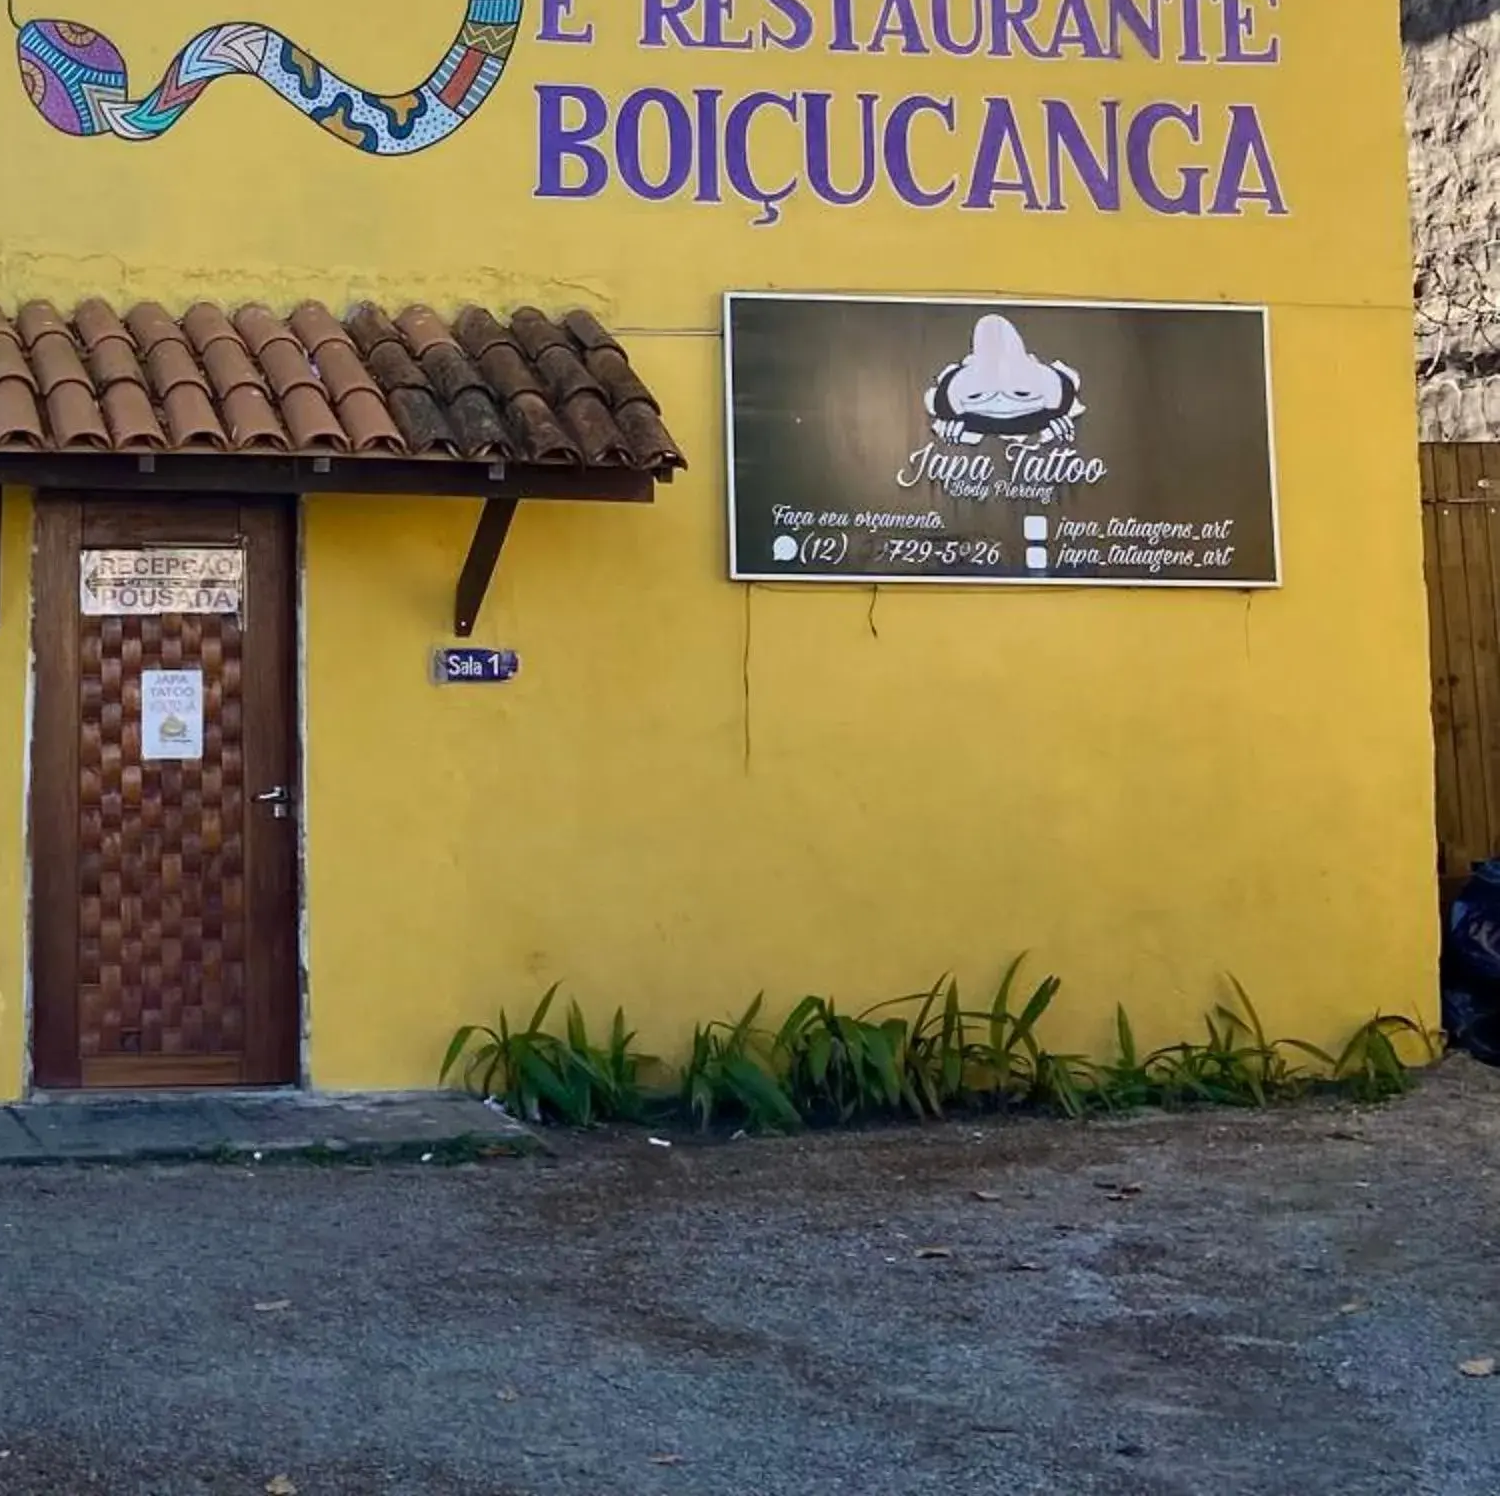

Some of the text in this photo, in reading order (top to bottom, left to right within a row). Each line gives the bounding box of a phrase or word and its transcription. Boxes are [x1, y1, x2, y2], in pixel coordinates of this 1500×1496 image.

[532, 82, 1290, 227] BOIÇUCANGA
[897, 441, 1107, 489] Japa Tattoo
[950, 480, 1055, 504] Body Piercing
[771, 503, 946, 532] Faça seu orçamento.
[1054, 516, 1235, 545] japa_tatuagens_art
[800, 531, 848, 565] (12)
[1054, 544, 1236, 573] japa_tatuagens_art
[101, 588, 234, 609] POUSADA
[448, 653, 500, 676] Sala 1
